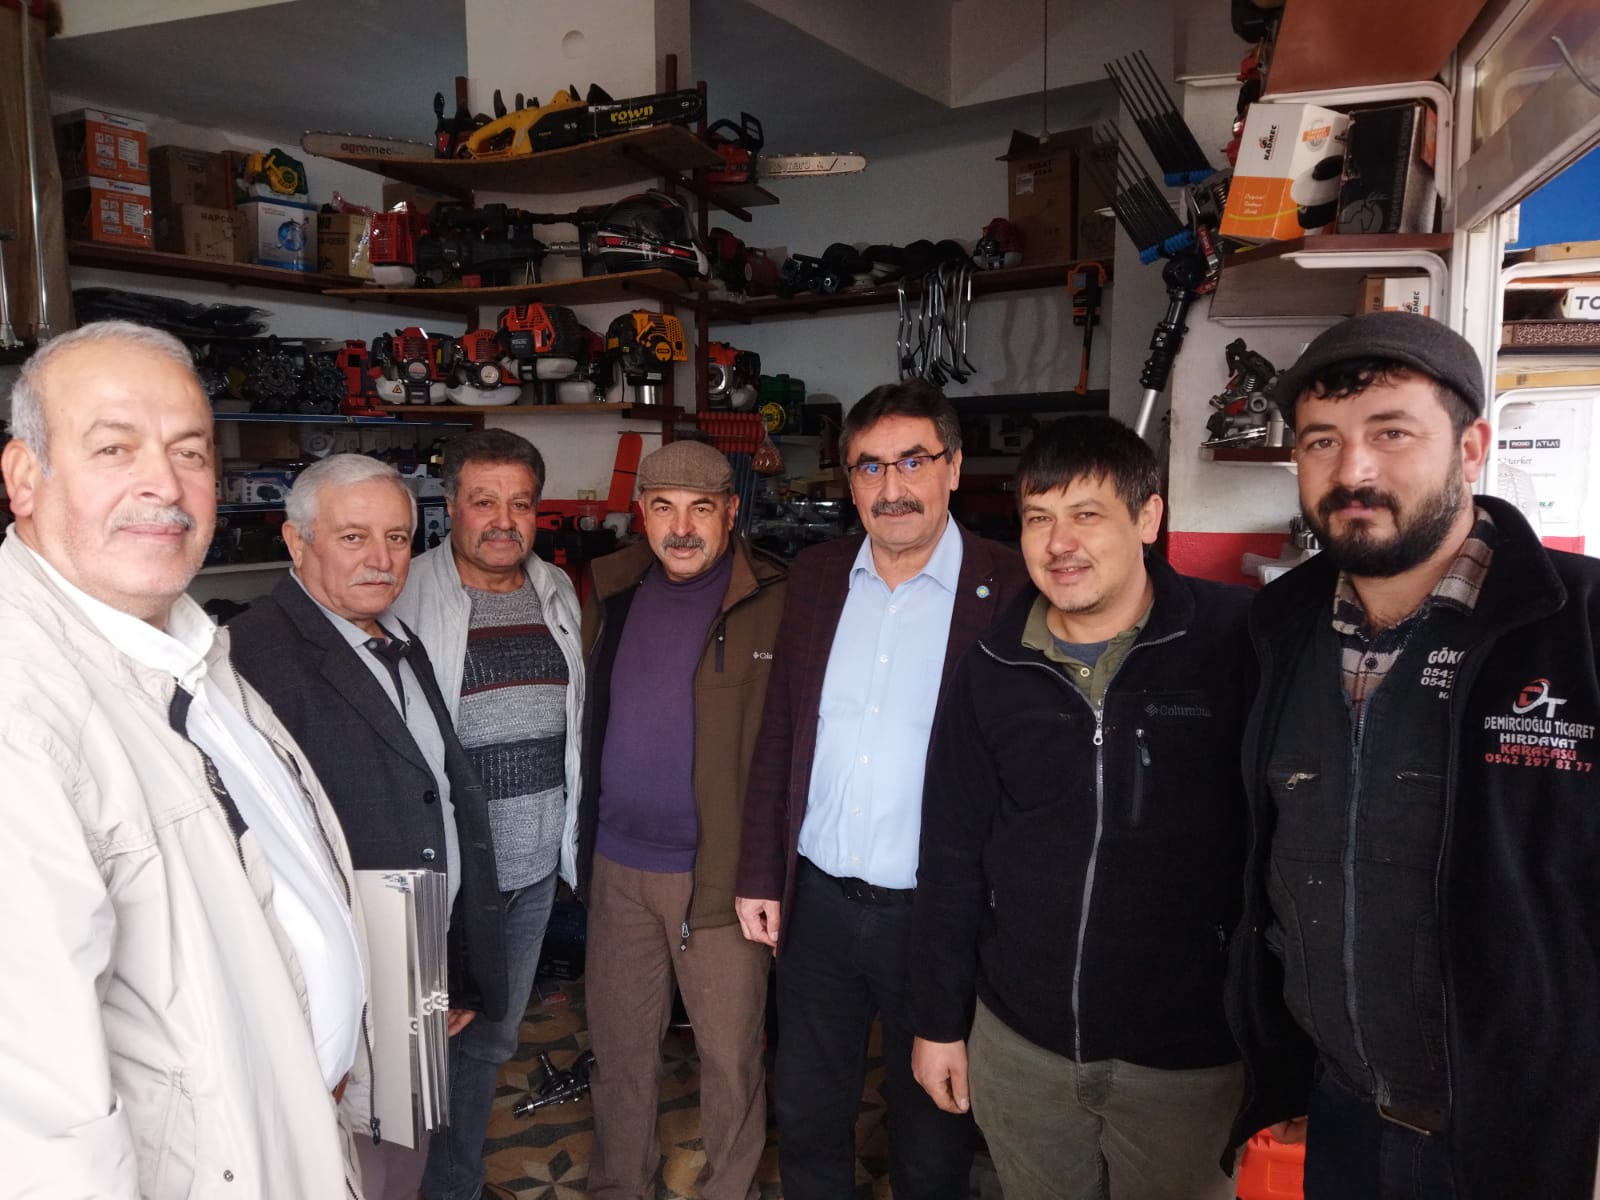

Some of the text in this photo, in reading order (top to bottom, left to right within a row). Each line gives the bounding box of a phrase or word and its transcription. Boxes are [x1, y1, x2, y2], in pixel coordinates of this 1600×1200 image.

[1264, 125, 1277, 160] KADMEC
[1484, 714, 1596, 739] DEMİRCİOĞLU TİCARET
[1500, 733, 1578, 749] HIRDAVAT
[1484, 752, 1520, 765] 0542
[1524, 756, 1551, 768] 297
[1500, 744, 1577, 760] KARACASU
